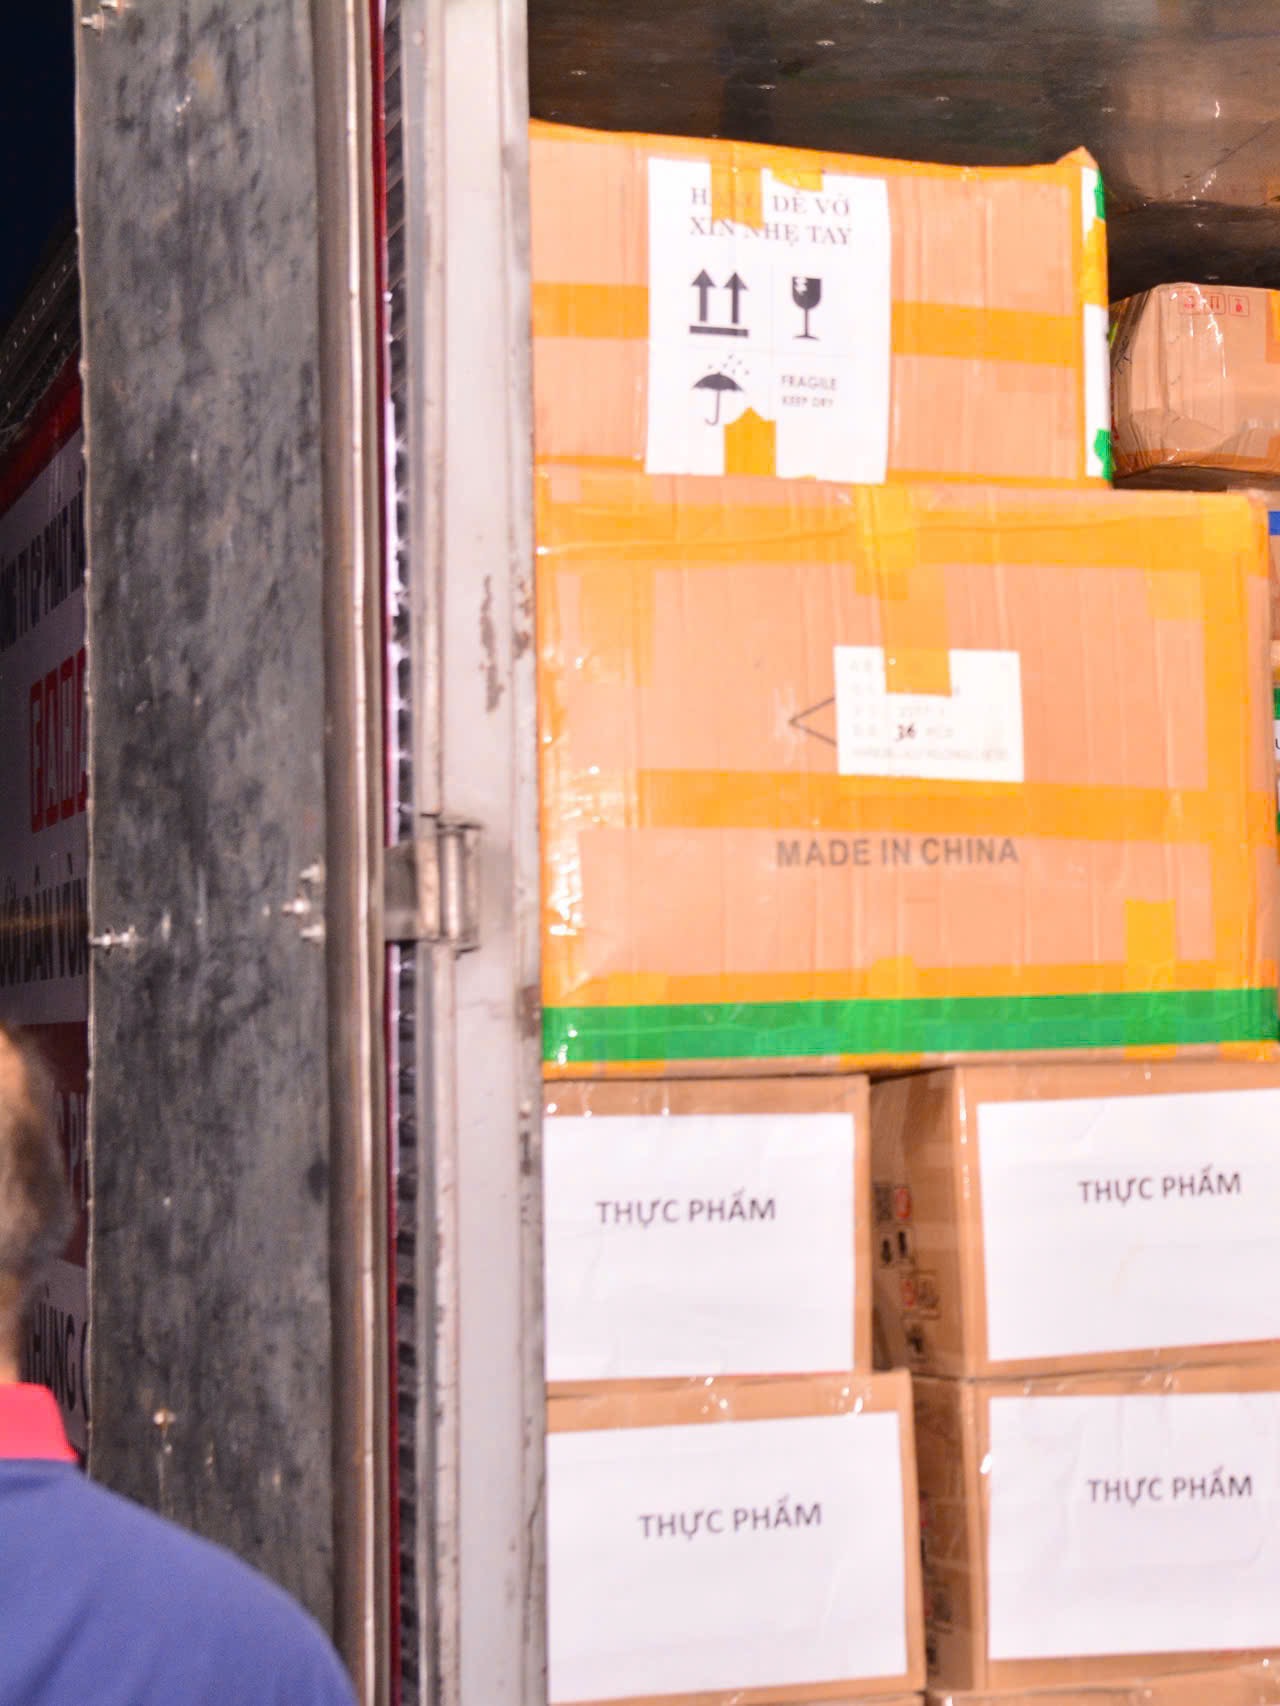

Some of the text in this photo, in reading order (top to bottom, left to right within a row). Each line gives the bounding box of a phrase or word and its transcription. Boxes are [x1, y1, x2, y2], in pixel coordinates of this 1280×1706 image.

[691, 216, 736, 236] XIN
[806, 225, 852, 245] TAY
[776, 837, 1019, 867] MADE IN CHINA
[1078, 1165, 1241, 1206] THỰC PHẨM
[595, 1188, 776, 1228] THỰC PHẨM
[1088, 1466, 1253, 1506] THỰC PHẨM
[639, 1494, 823, 1540] THỰC PHẨM
